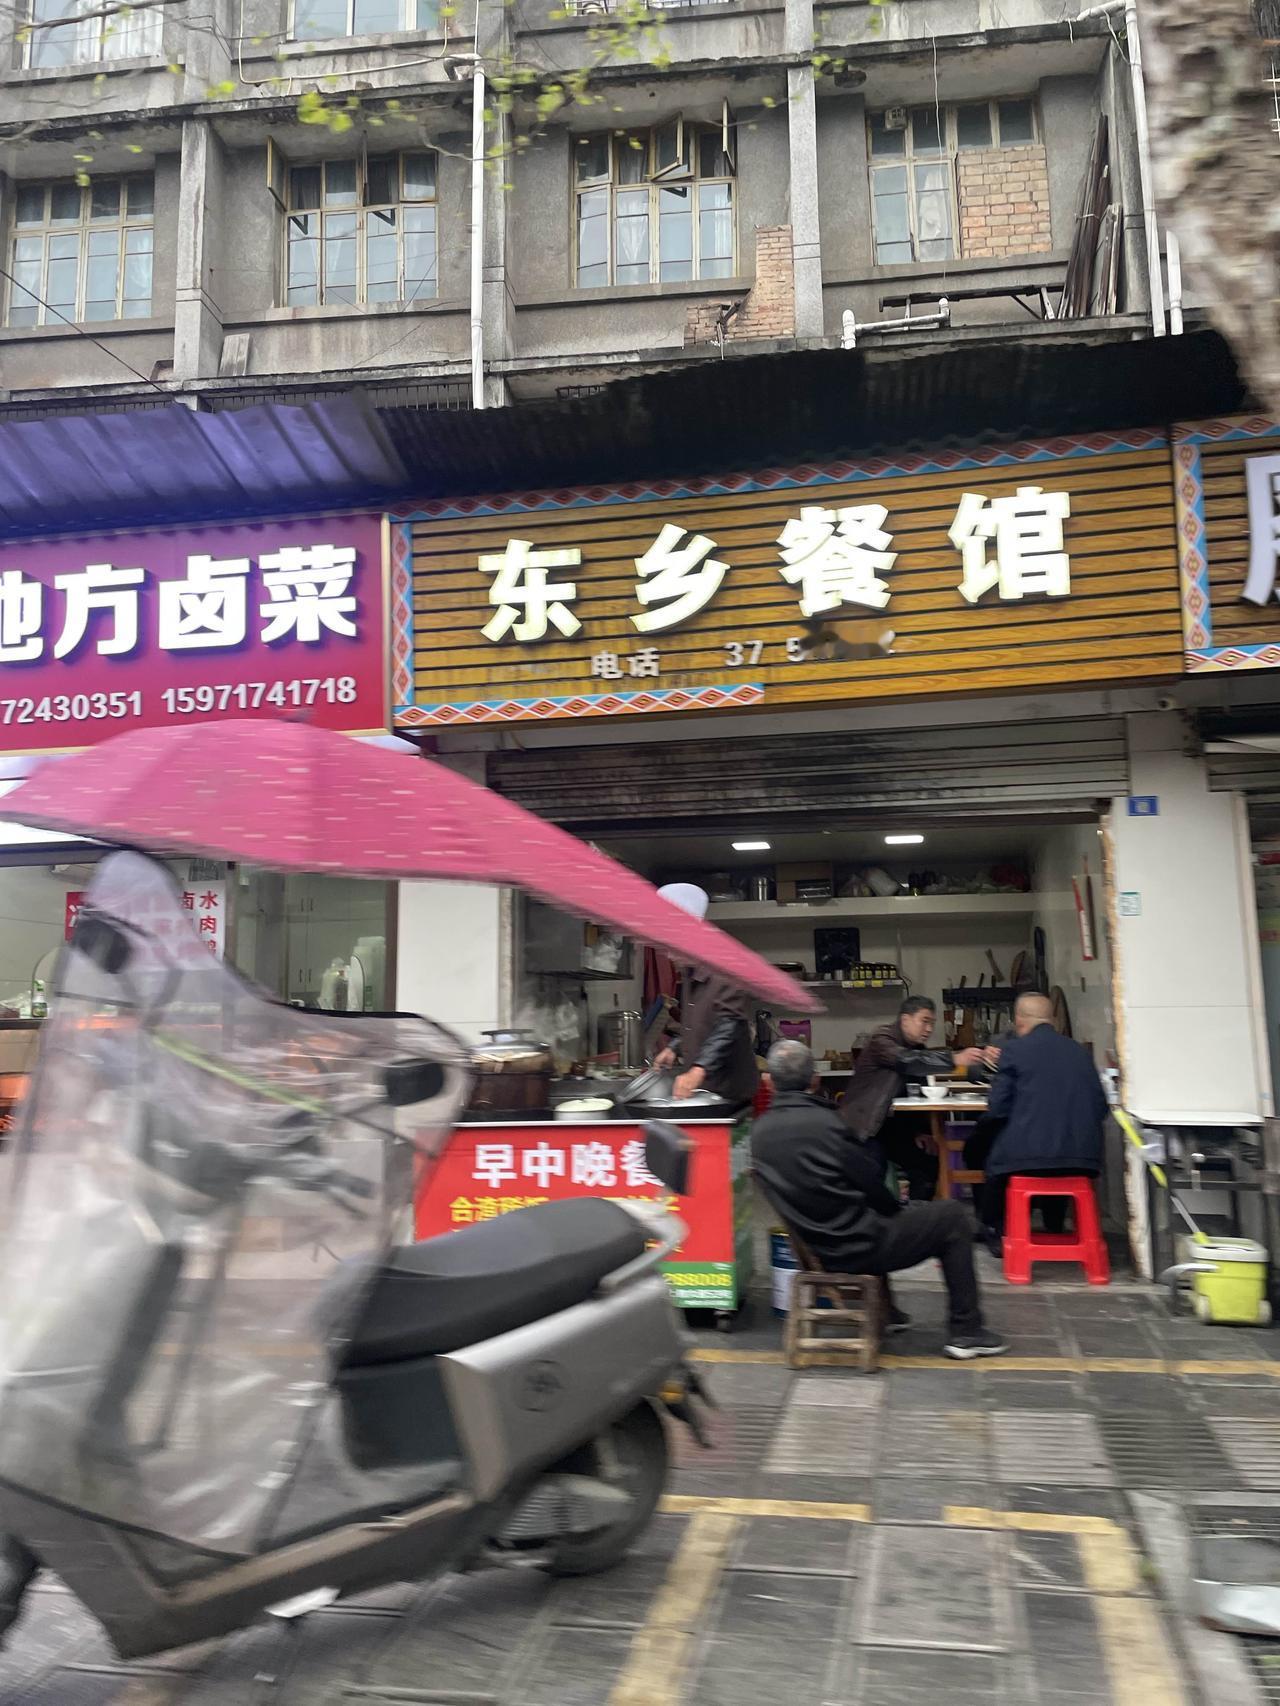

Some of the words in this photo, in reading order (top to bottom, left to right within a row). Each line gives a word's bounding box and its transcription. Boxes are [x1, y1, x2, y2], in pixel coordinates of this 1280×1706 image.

[478, 486, 1070, 641] 东乡餐馆
[591, 647, 660, 679] 电话
[1, 690, 142, 724] 72430351
[161, 676, 357, 713] 15971741718
